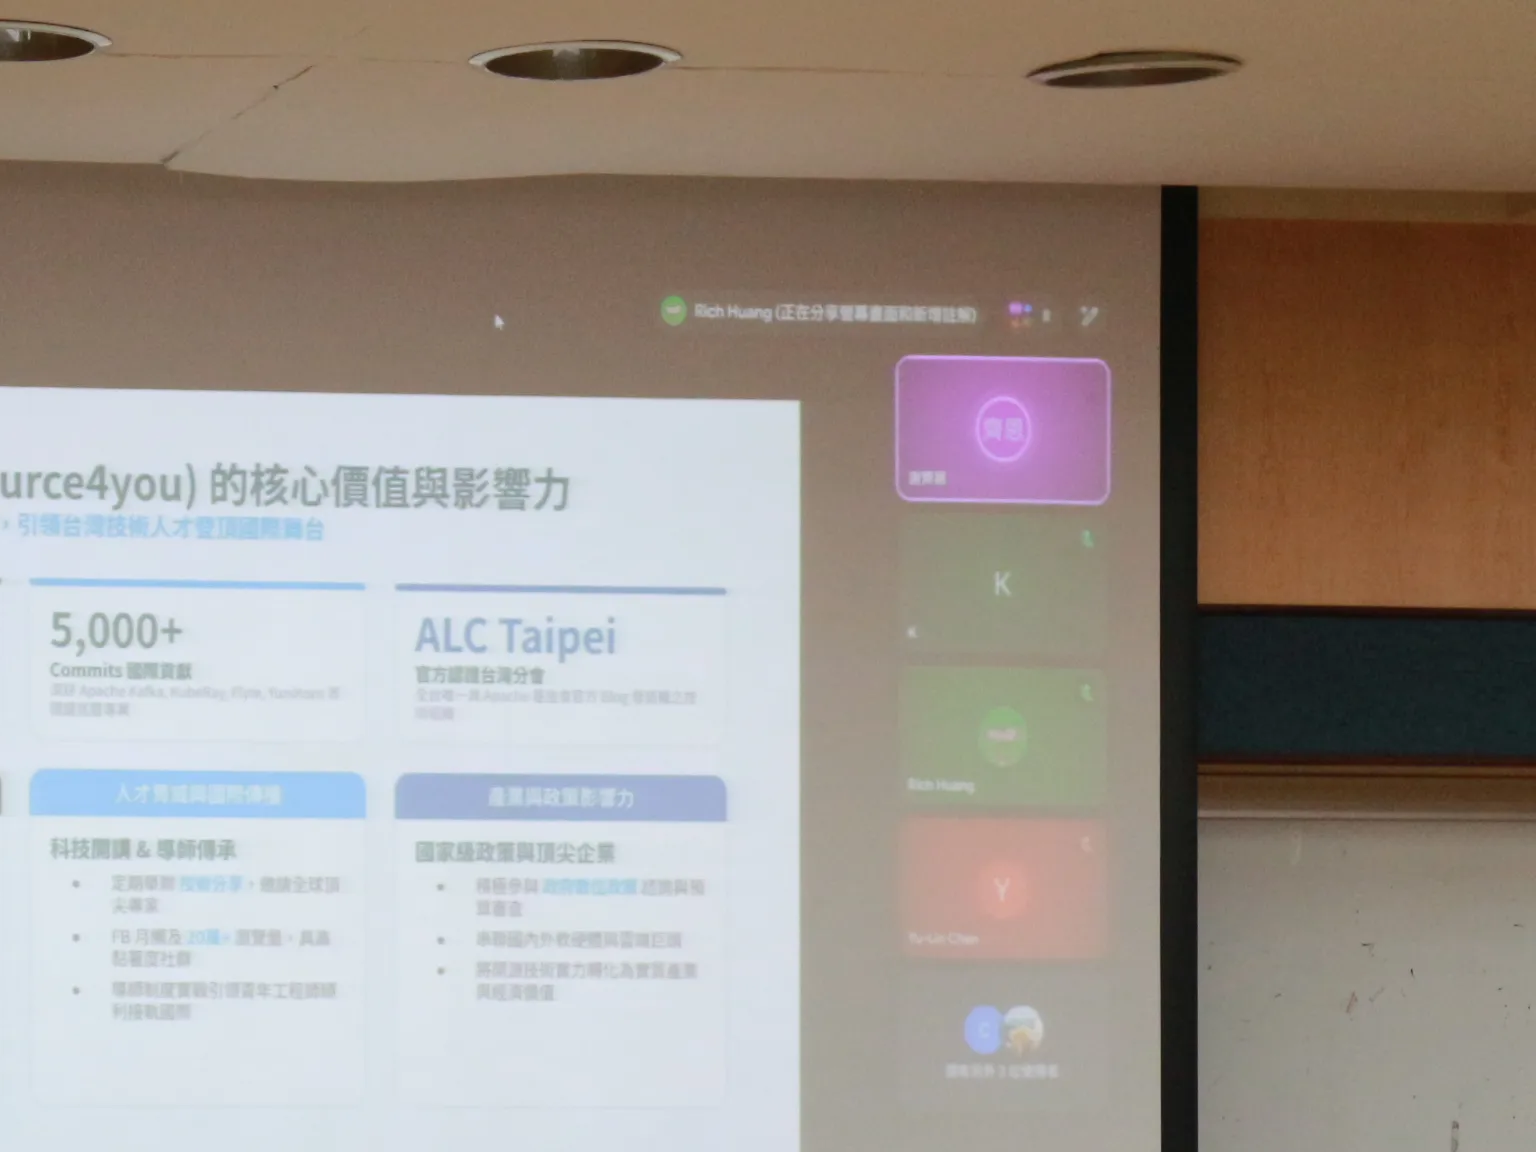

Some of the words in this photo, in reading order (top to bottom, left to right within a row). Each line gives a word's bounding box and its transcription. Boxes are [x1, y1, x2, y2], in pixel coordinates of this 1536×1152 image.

[694, 303, 725, 319] Rich
[728, 304, 772, 322] Huang
[210, 462, 571, 513] 的核心價值與影響力
[994, 570, 1012, 596] K
[49, 610, 183, 658] 5,000+
[415, 616, 488, 654] ALC
[498, 615, 617, 664] Taipei
[49, 662, 123, 678] Commits
[136, 841, 152, 859] &
[993, 876, 1012, 902] Y
